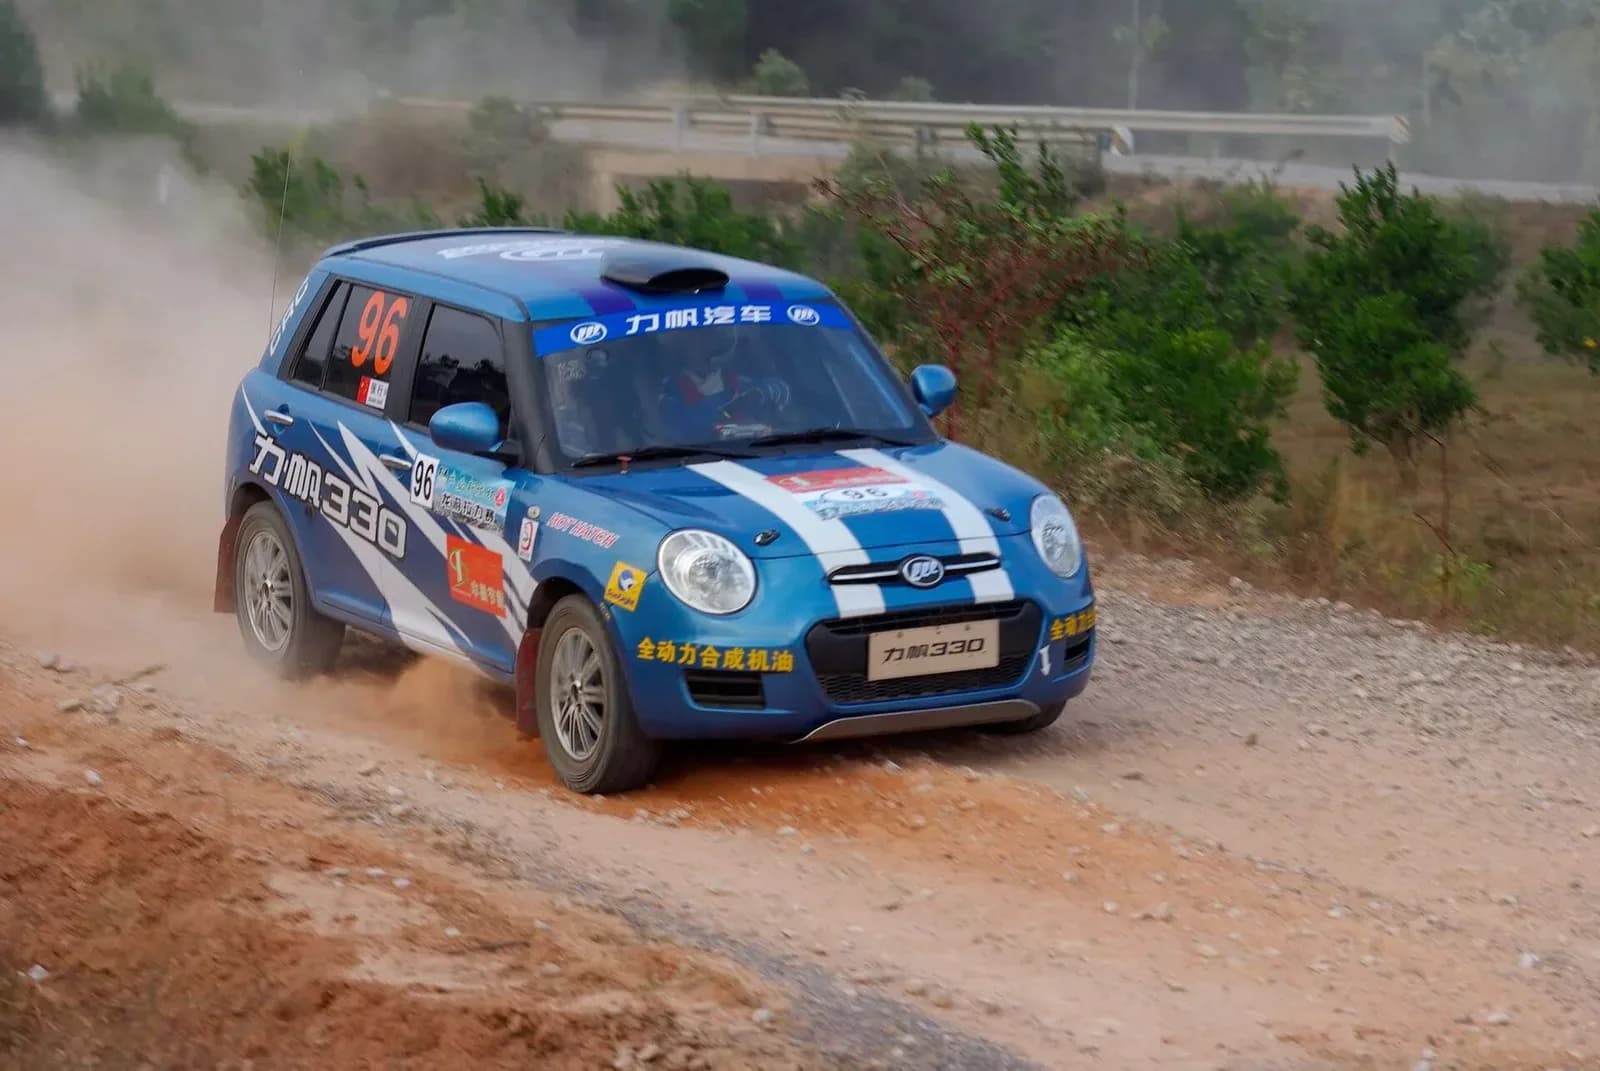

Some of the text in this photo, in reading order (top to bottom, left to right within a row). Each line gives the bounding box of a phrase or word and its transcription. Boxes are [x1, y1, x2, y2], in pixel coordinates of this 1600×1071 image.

[351, 289, 408, 375] 96
[625, 305, 771, 335] 力帆汽车
[414, 461, 434, 501] 96
[637, 636, 793, 673] 全动力合成机油
[882, 638, 985, 664] 力帆330
